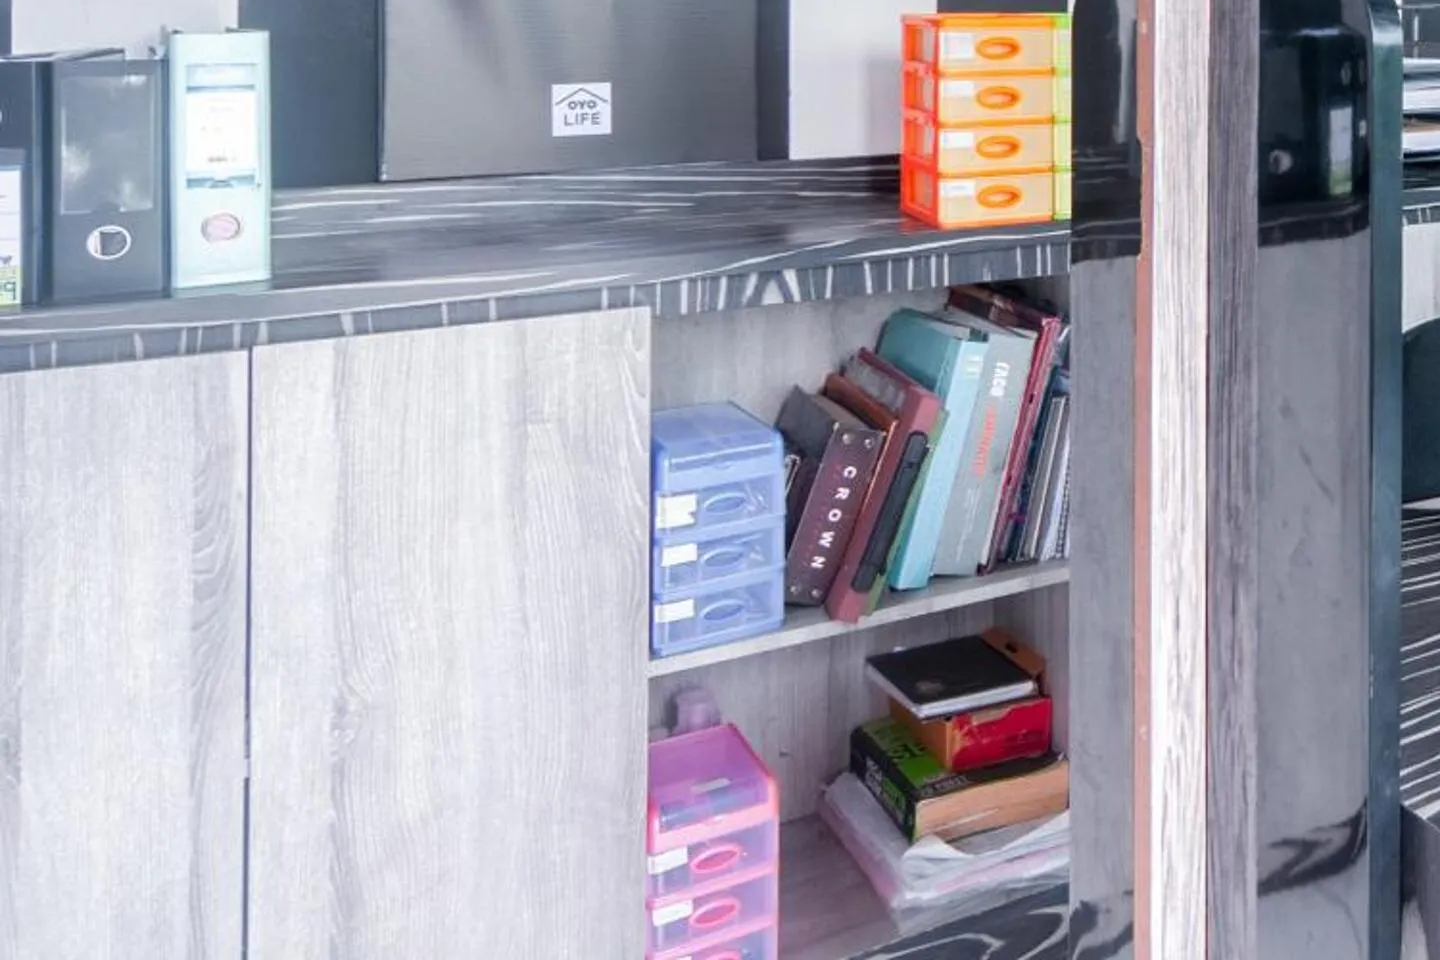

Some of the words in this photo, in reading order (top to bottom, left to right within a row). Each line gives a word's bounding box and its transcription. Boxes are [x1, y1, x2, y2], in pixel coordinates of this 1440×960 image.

[567, 99, 598, 110] OYO
[563, 111, 601, 127] LIFE
[810, 465, 858, 569] CROWN
